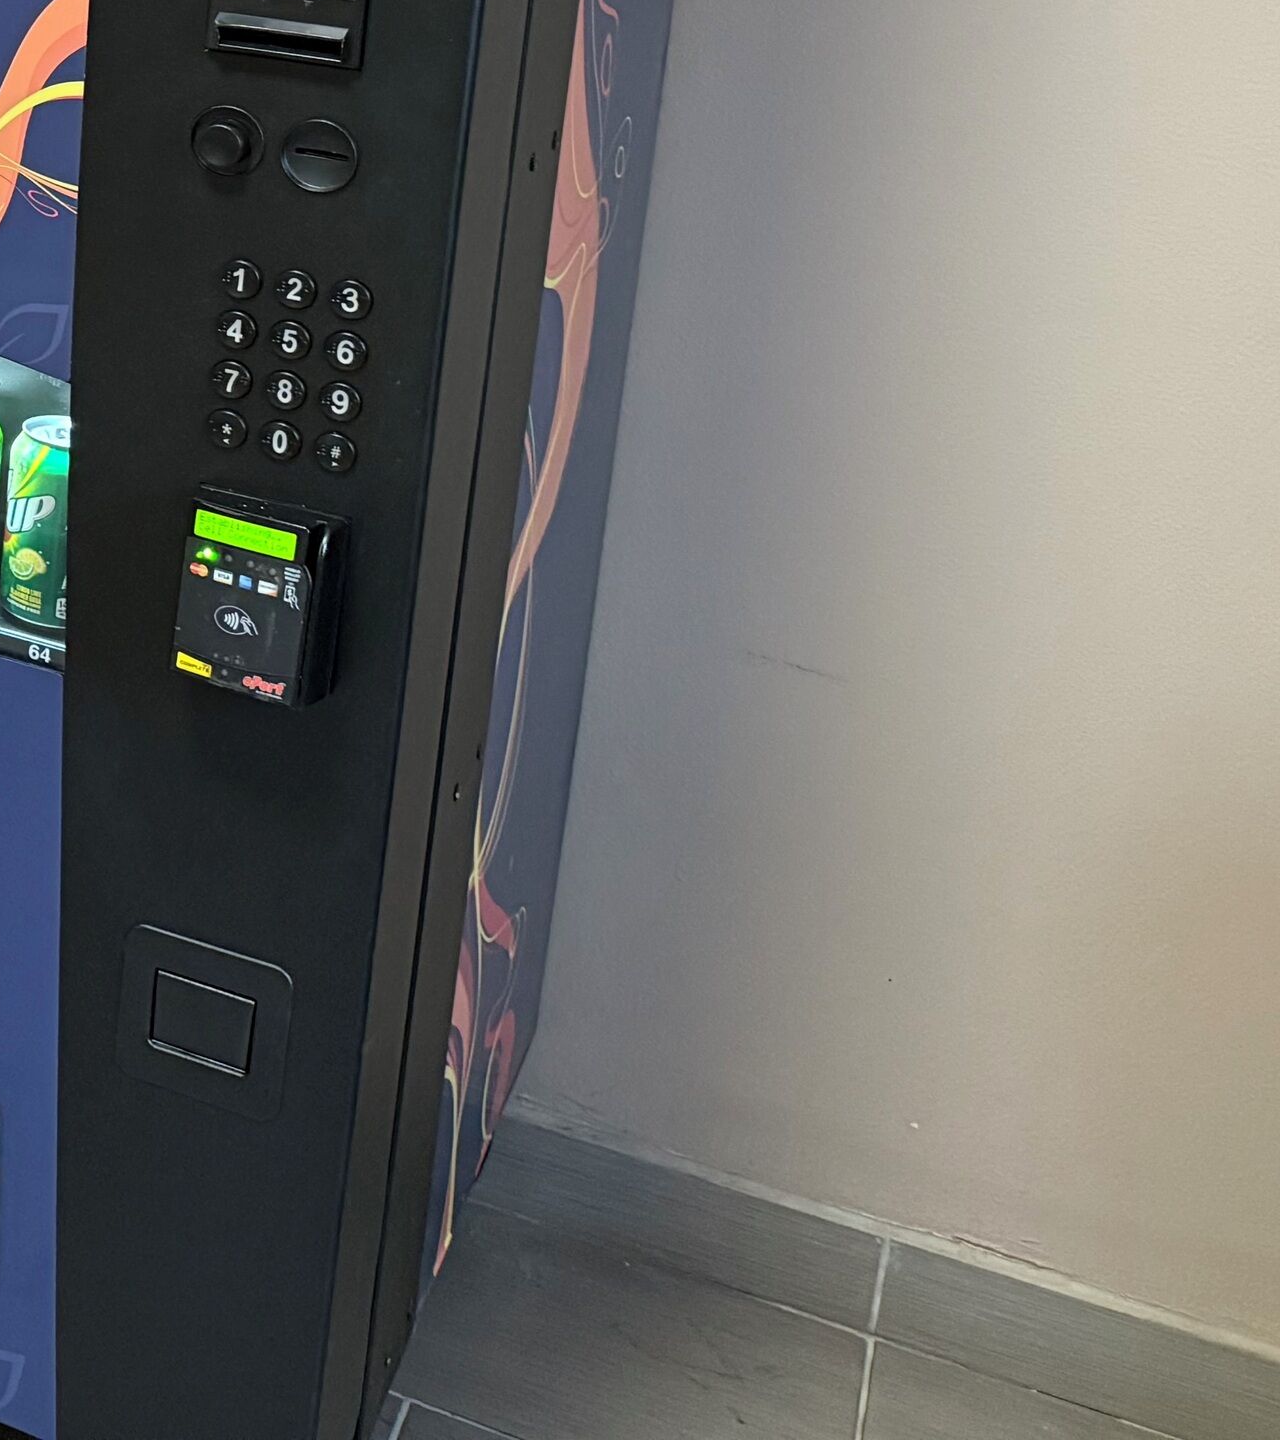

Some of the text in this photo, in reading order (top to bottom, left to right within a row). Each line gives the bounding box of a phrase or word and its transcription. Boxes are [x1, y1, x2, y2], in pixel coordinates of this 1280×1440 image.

[233, 268, 359, 313] 1 2 3
[226, 319, 354, 365] 4 5 6
[224, 368, 350, 415] 7 8 9
[272, 430, 288, 454] 0
[28, 644, 51, 663] 64
[179, 659, 210, 674] COMPLETE
[242, 675, 286, 696] ePort
